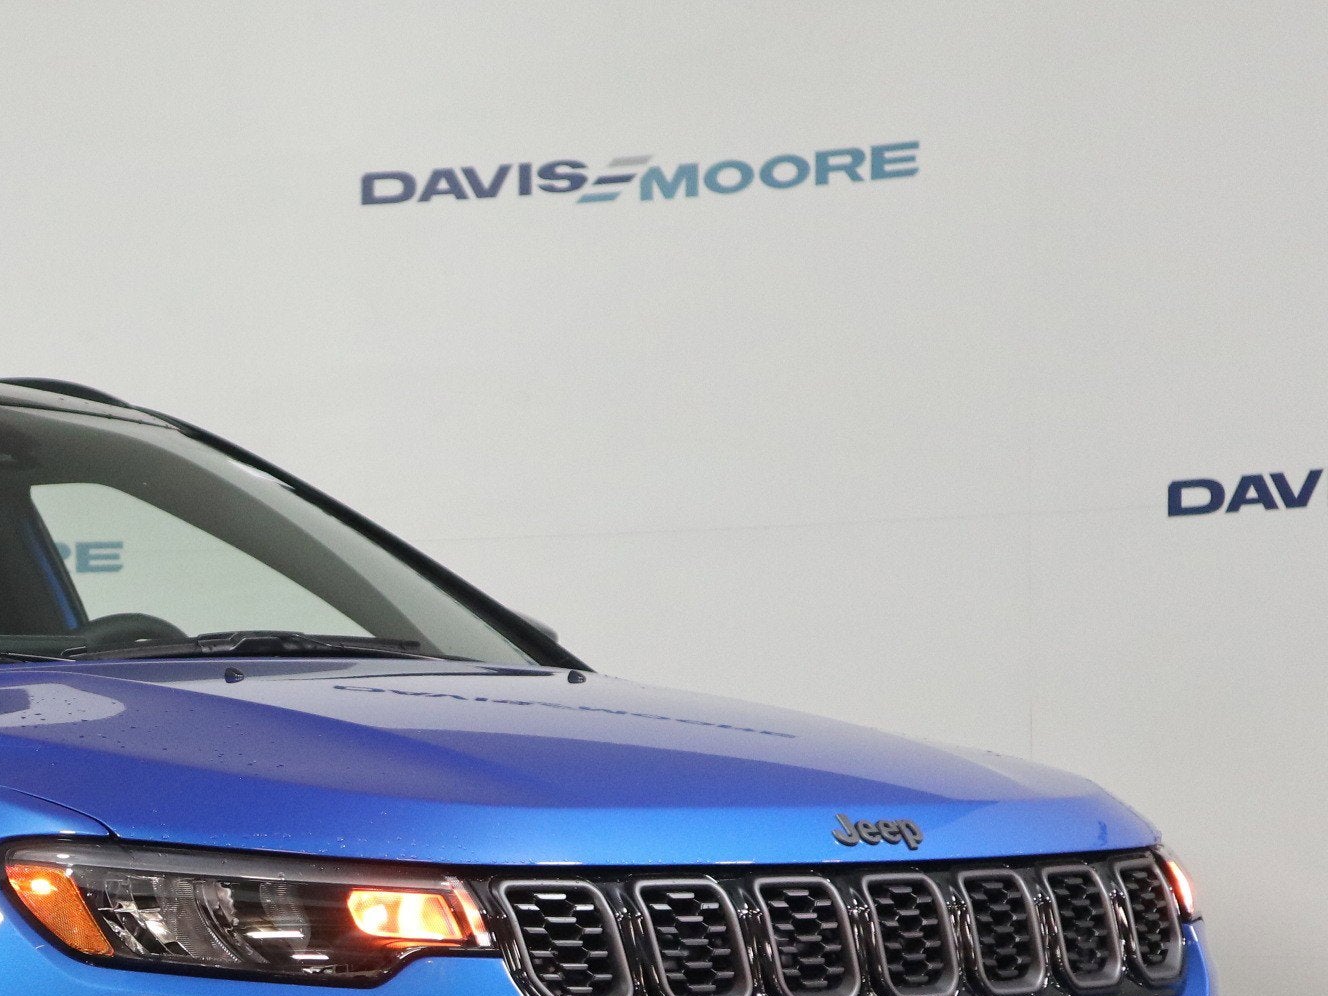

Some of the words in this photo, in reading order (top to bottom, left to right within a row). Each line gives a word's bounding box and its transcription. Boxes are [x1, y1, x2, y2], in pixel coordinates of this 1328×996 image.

[360, 159, 589, 206] DAVIS
[639, 140, 920, 202] MOORE
[832, 813, 924, 851] Jeep
